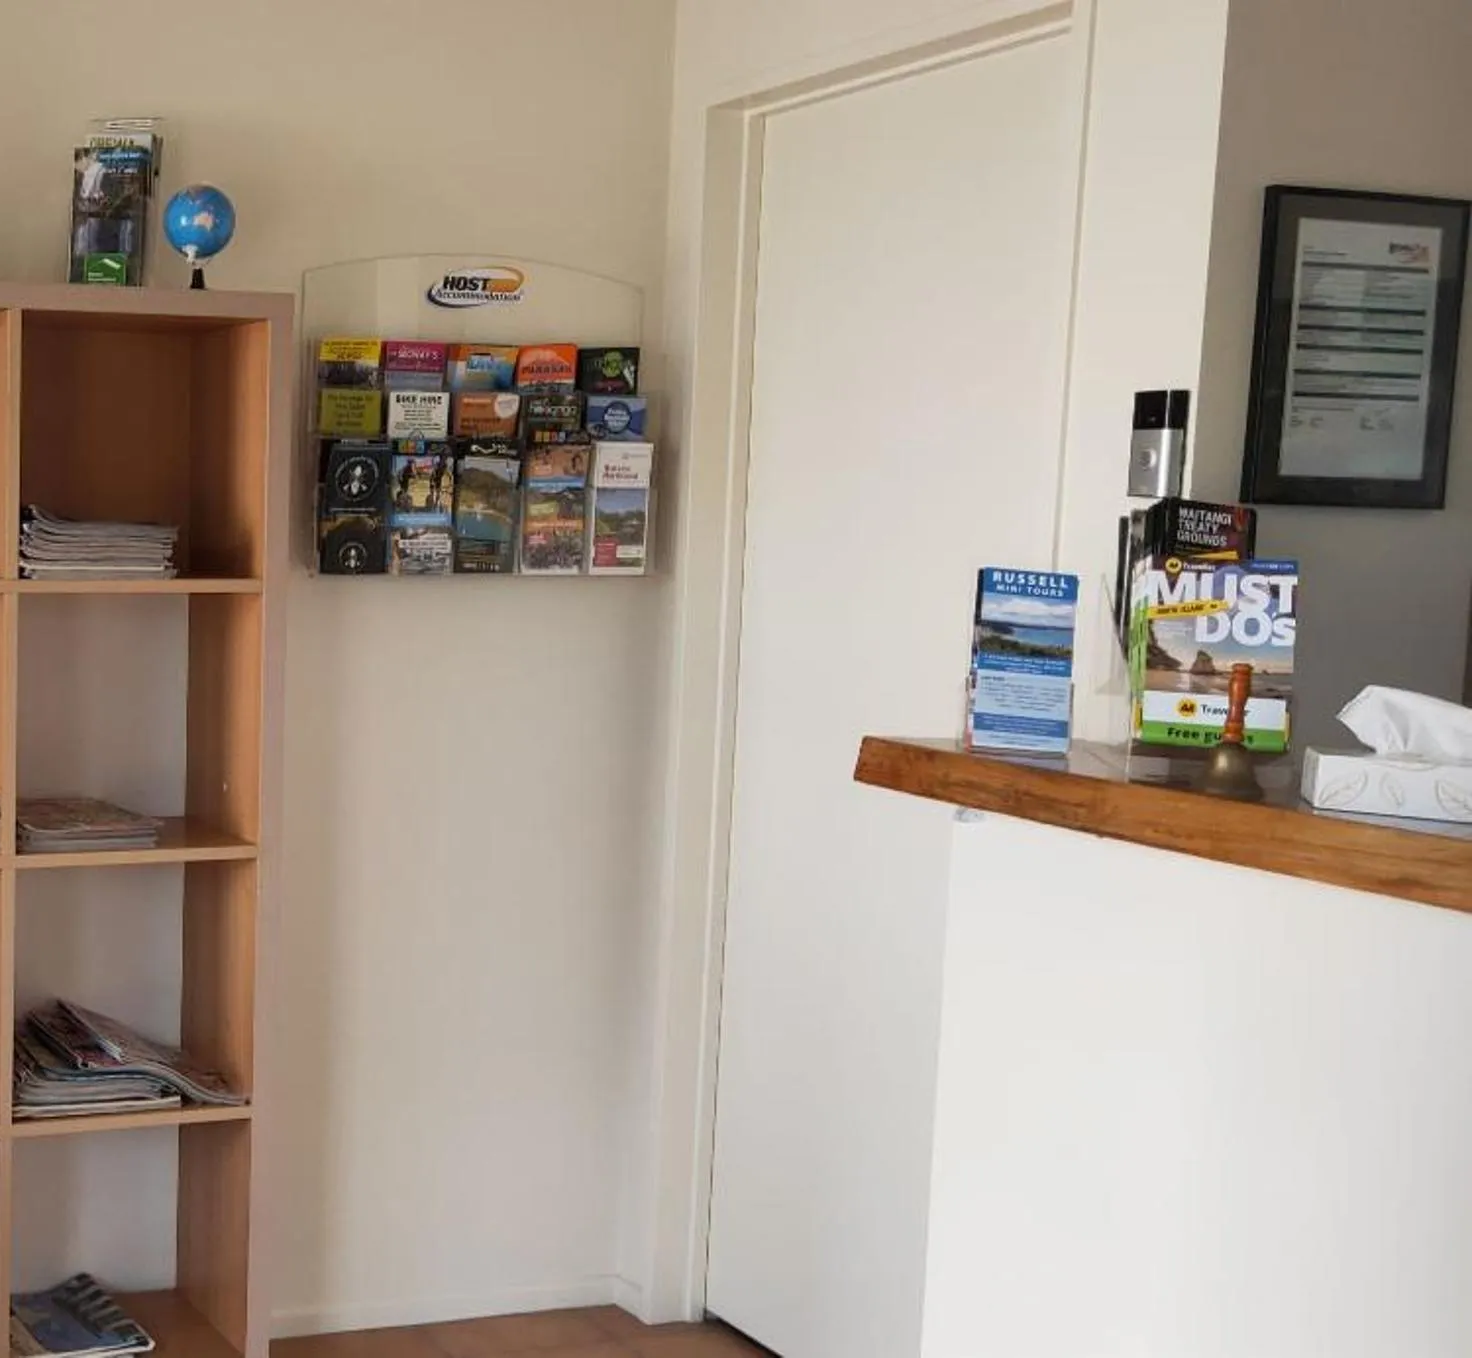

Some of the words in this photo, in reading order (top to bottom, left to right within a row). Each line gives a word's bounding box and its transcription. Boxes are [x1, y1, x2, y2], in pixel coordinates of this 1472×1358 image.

[443, 275, 492, 291] HOST
[1178, 506, 1232, 525] WAITANGI
[1178, 519, 1220, 534] TREATY
[1177, 529, 1228, 547] GROUNDS
[992, 571, 1069, 589] RUSSELL
[996, 583, 1022, 594] MINI
[1027, 585, 1065, 598] TOURS
[1145, 570, 1299, 614] MUST
[1167, 727, 1200, 740] Free
